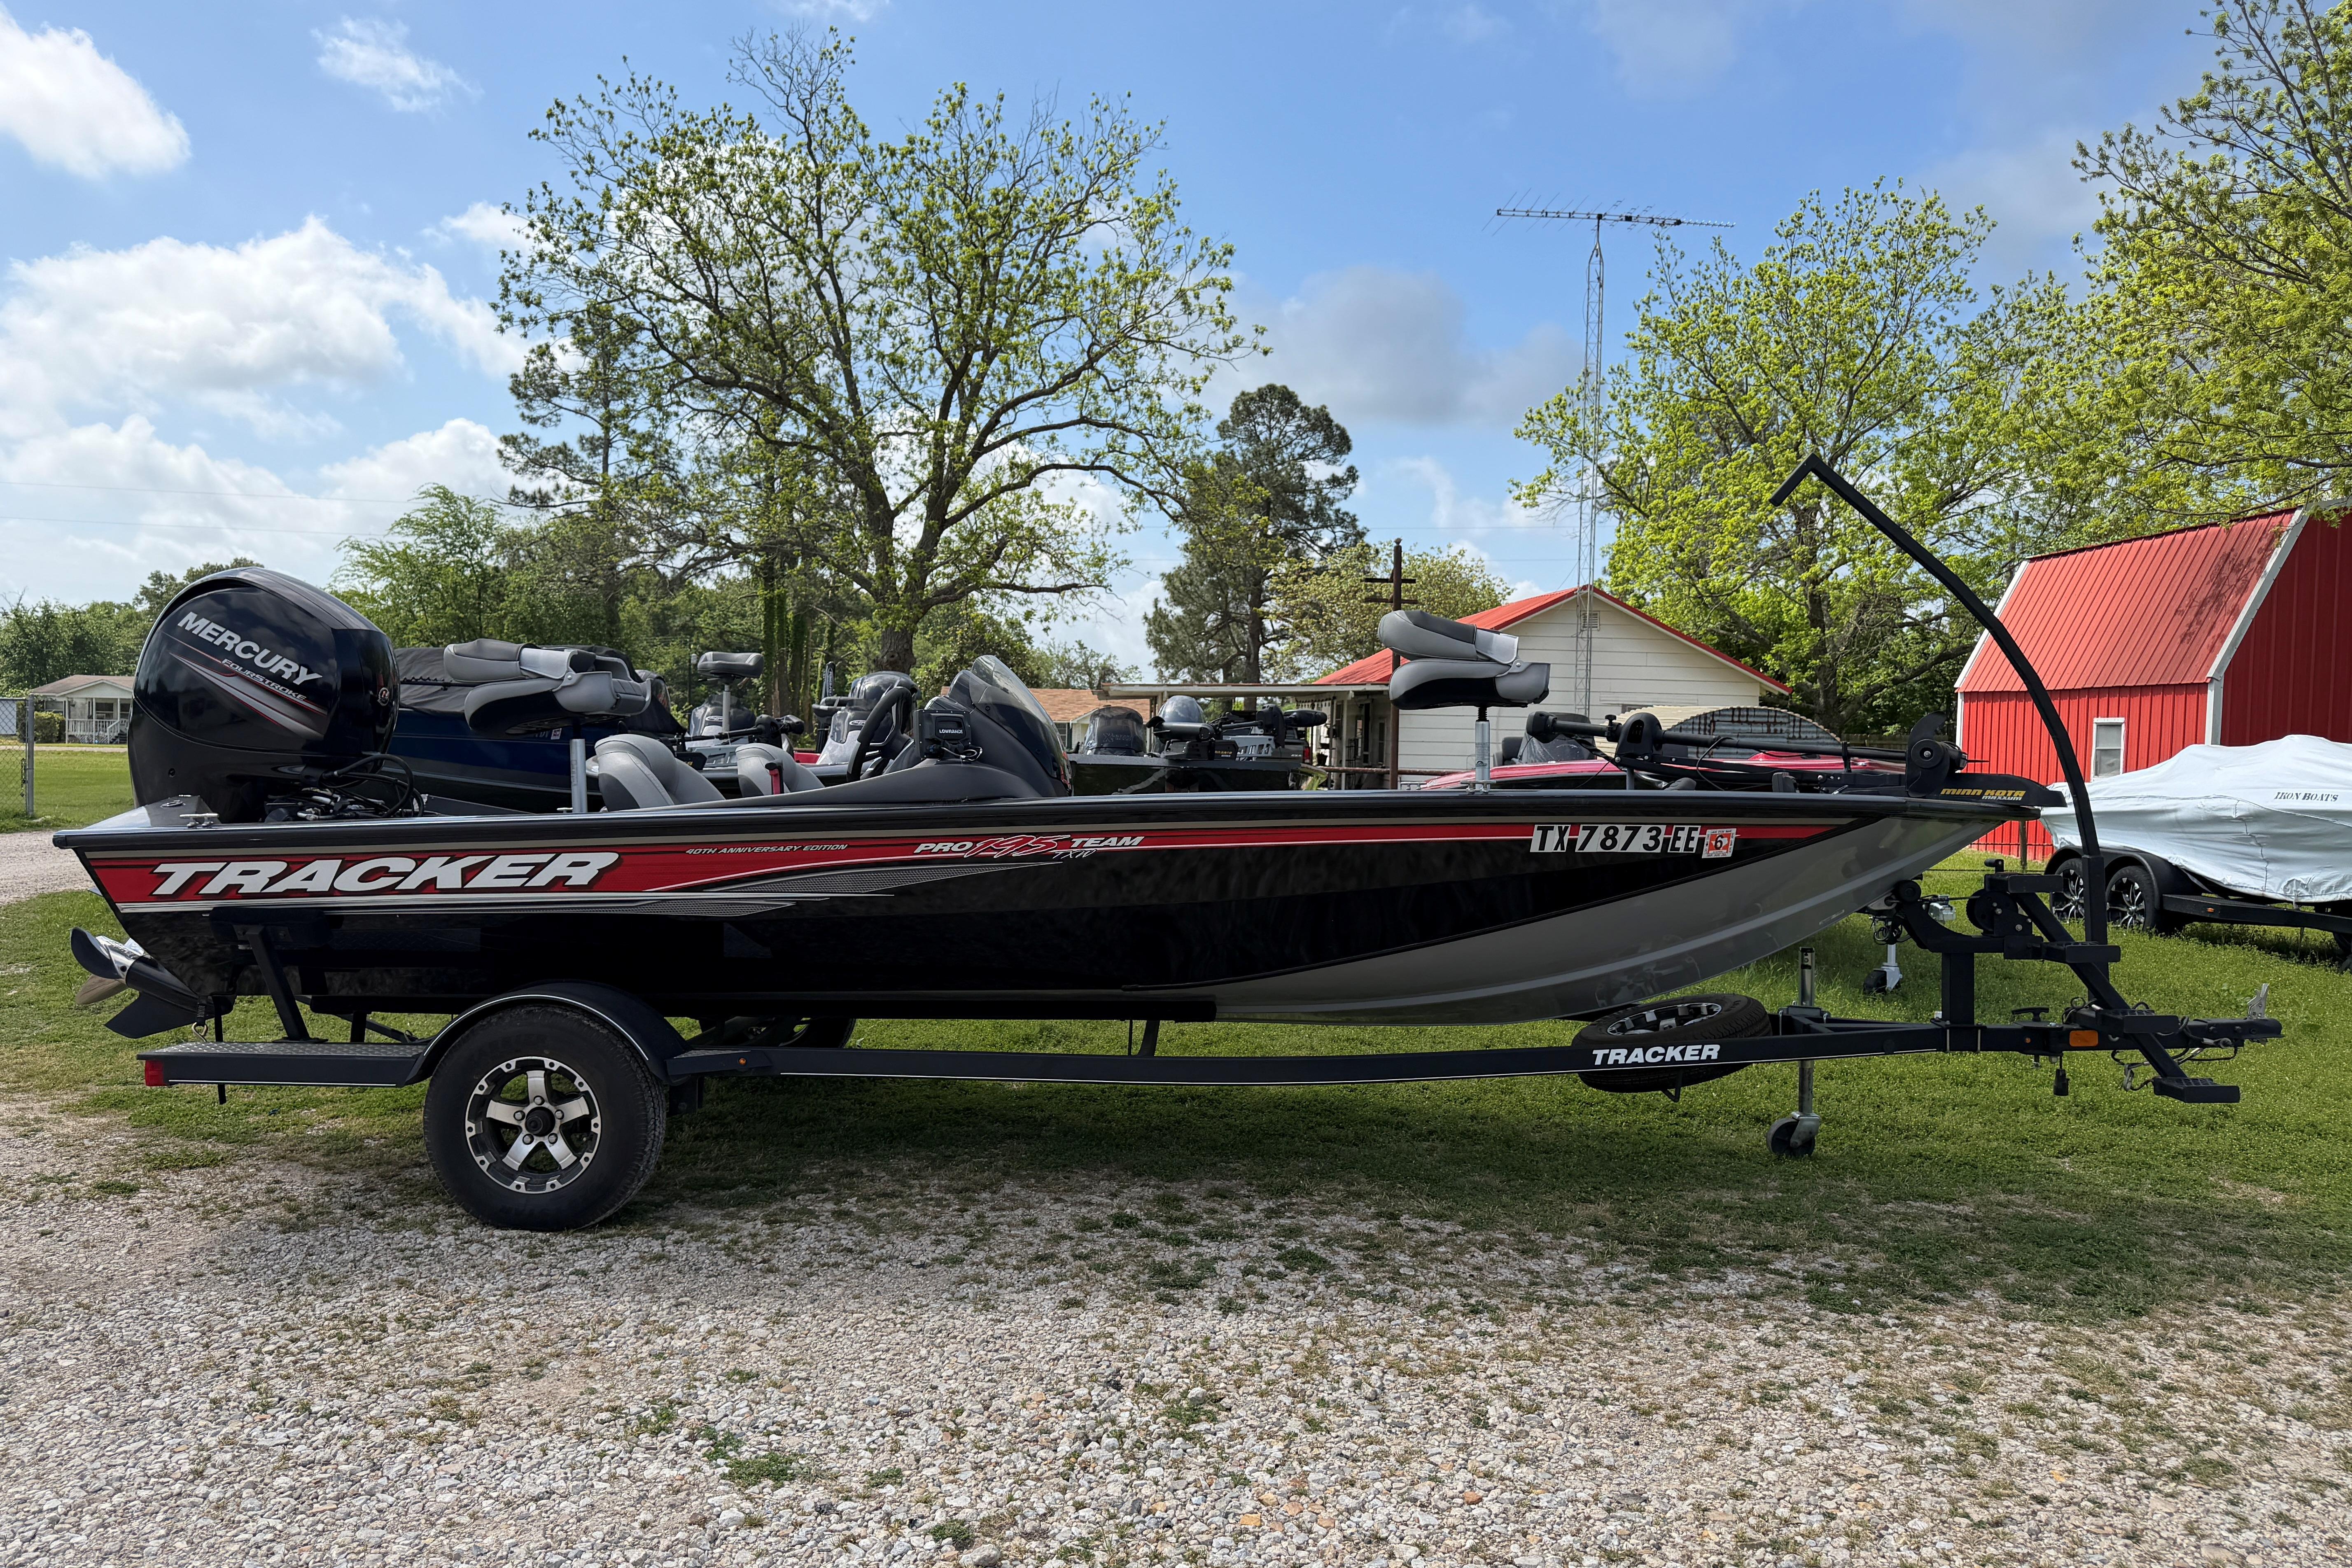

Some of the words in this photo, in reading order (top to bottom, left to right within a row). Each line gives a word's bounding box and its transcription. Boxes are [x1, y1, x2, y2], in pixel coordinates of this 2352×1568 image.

[177, 611, 322, 685] MERCURY
[222, 658, 307, 700] FOURSTROKE
[2302, 793, 2338, 802] BOATS
[717, 845, 802, 854] ANNIVERSARY
[913, 842, 973, 853] PRO
[964, 835, 1071, 858] 195
[1071, 837, 1145, 848] TEAM
[1536, 826, 1569, 851] TX
[1578, 826, 1662, 851] 7873
[1670, 827, 1699, 852] EE
[1714, 835, 1724, 850] 6
[1052, 849, 1098, 859] TXW
[151, 852, 619, 895] TRACKER
[1592, 1044, 1721, 1065] TRACKER
